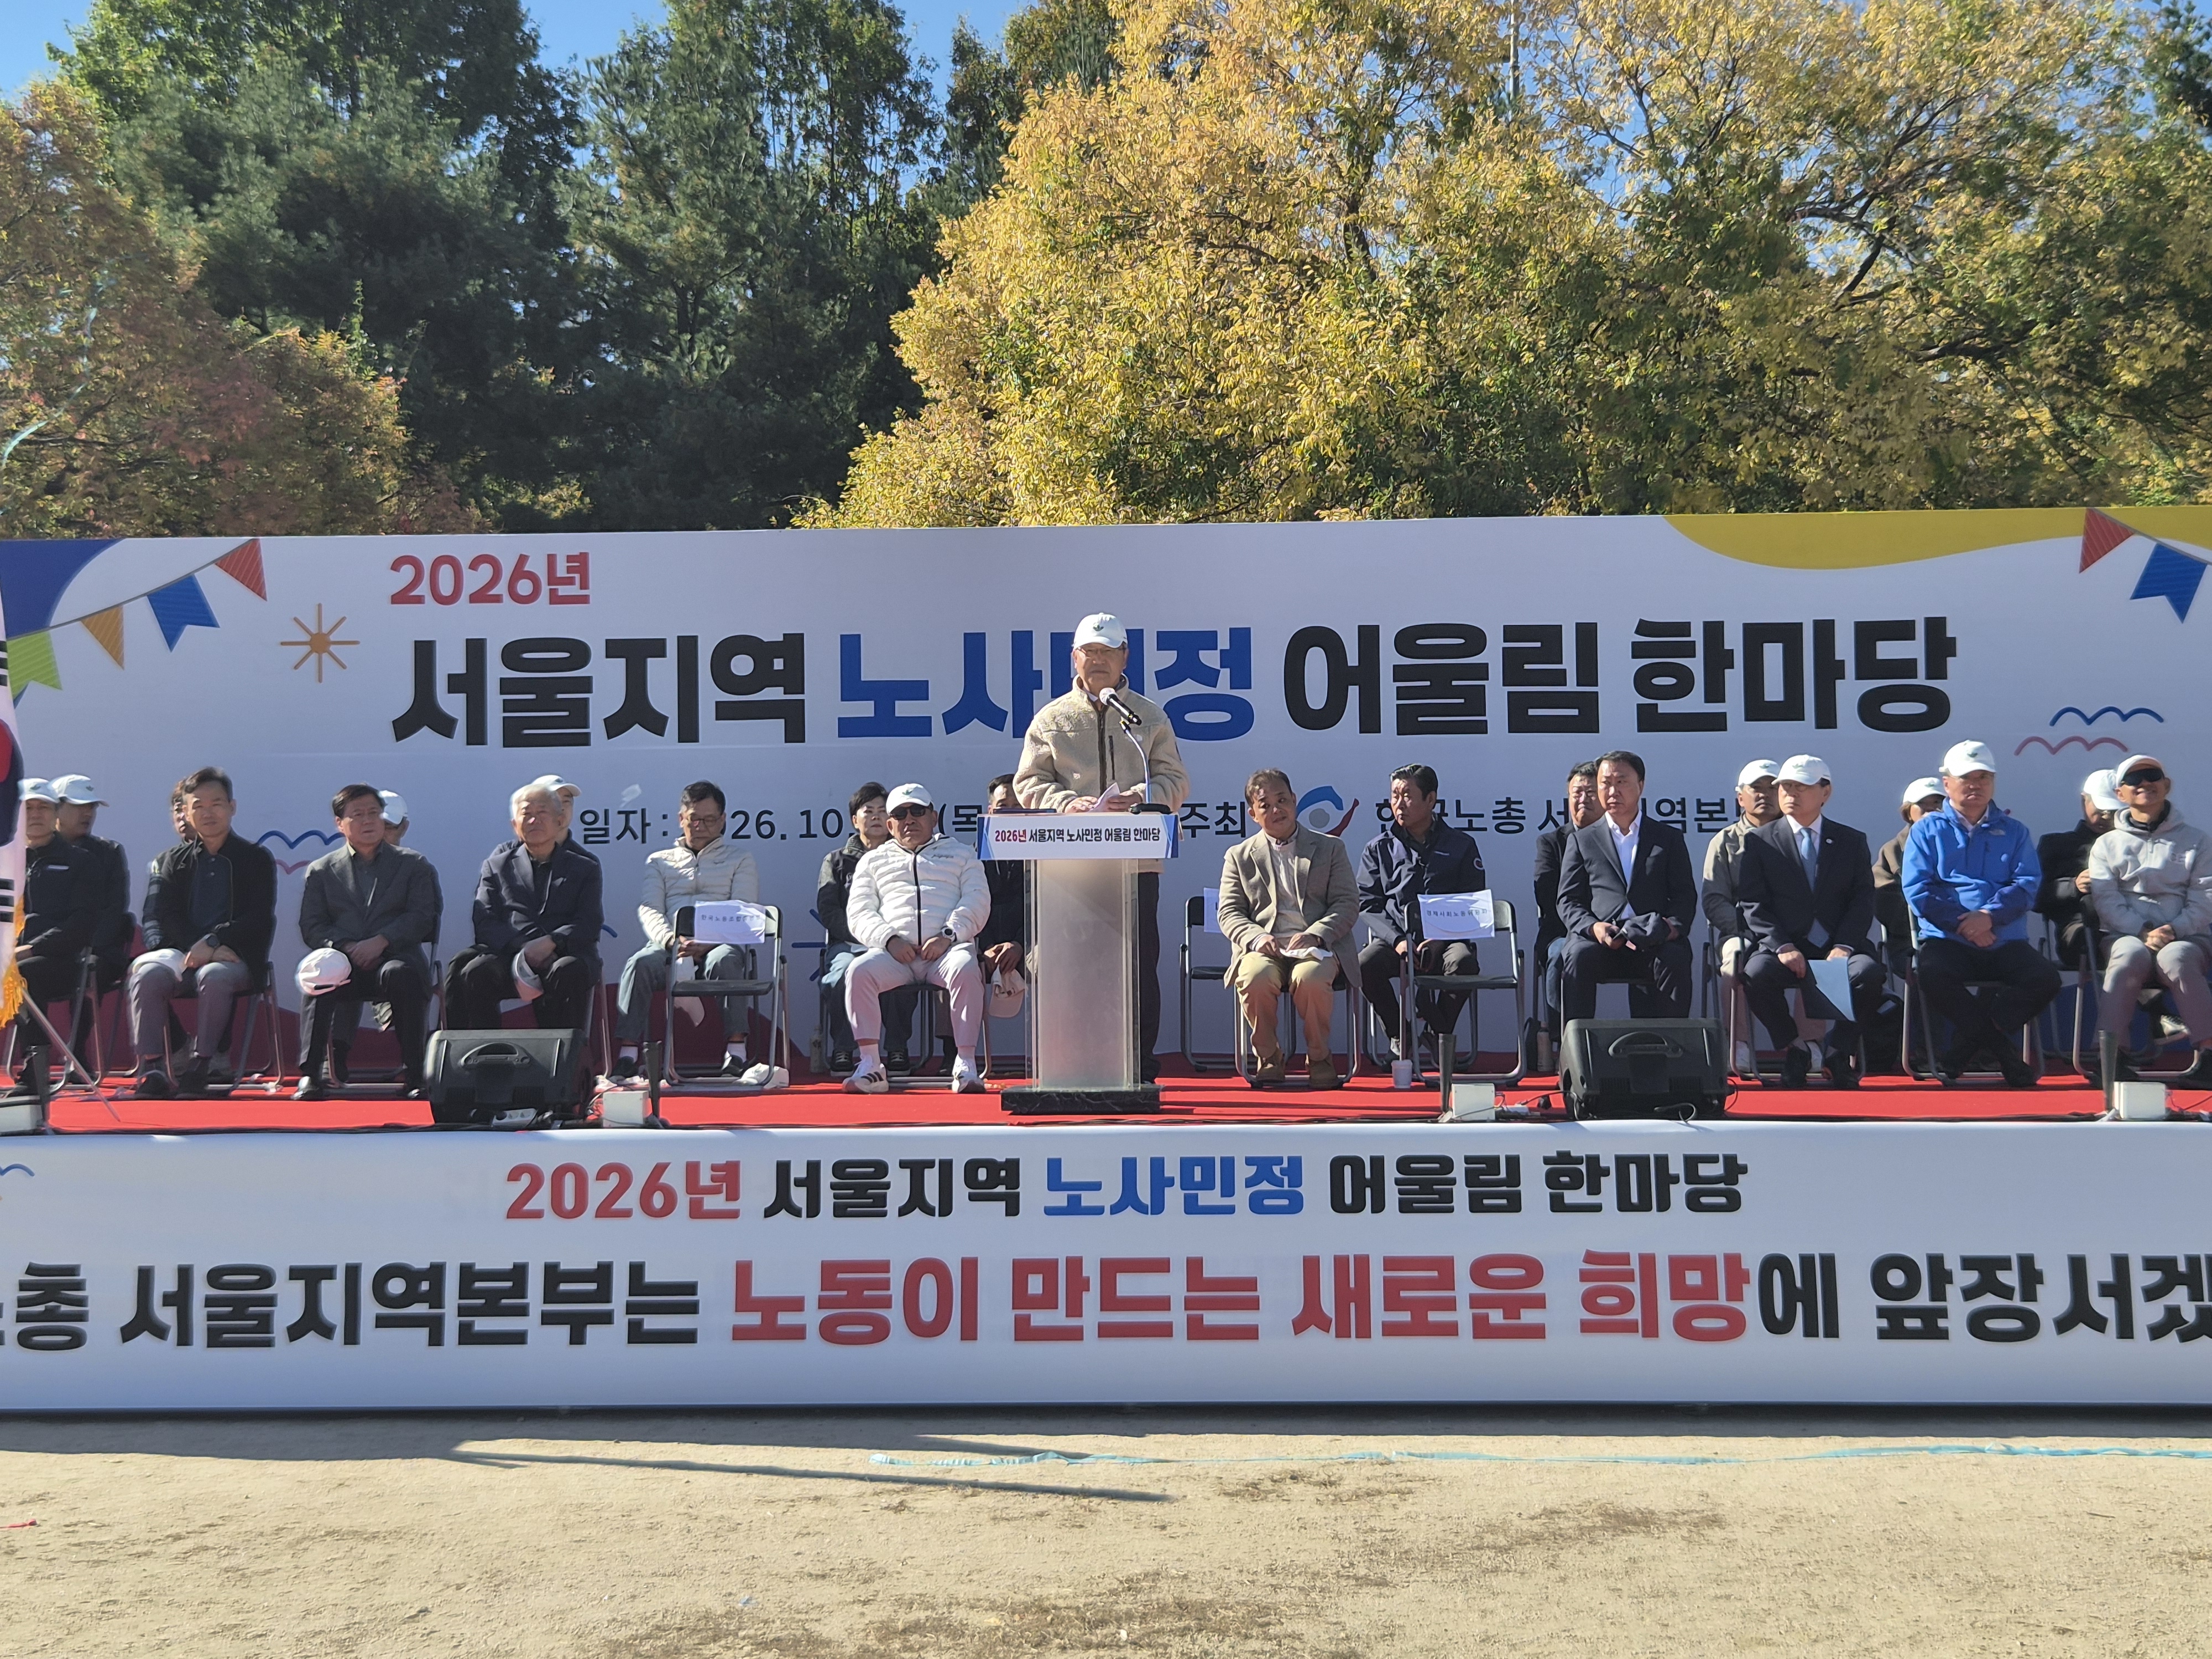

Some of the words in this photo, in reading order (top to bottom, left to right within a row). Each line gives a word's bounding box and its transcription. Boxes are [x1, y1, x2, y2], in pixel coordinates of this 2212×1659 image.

[390, 552, 589, 605] 2026년
[392, 633, 805, 748] 서울지역
[1284, 623, 1599, 735] 어울림
[1631, 617, 1957, 732] 한마당
[995, 830, 1027, 843] 2026년
[1029, 829, 1065, 842] 서울지역
[1067, 828, 1103, 842] 노사민정
[1104, 828, 1131, 842] 어울림
[1133, 827, 1161, 841] 한마당
[507, 1161, 740, 1219] 2026년
[764, 1158, 1020, 1218] 서울지역
[1044, 1156, 1303, 1215] 노사민정
[1330, 1155, 1522, 1213] 어울림
[1543, 1151, 1747, 1212] 한마당
[0, 1262, 89, 1350] 총
[120, 1261, 699, 1348] 서울지역본부는
[732, 1258, 978, 1345] 노동이
[1012, 1256, 1260, 1341] 만드는
[1292, 1255, 1546, 1339] 새로운
[1579, 1248, 1839, 1342] 희망에
